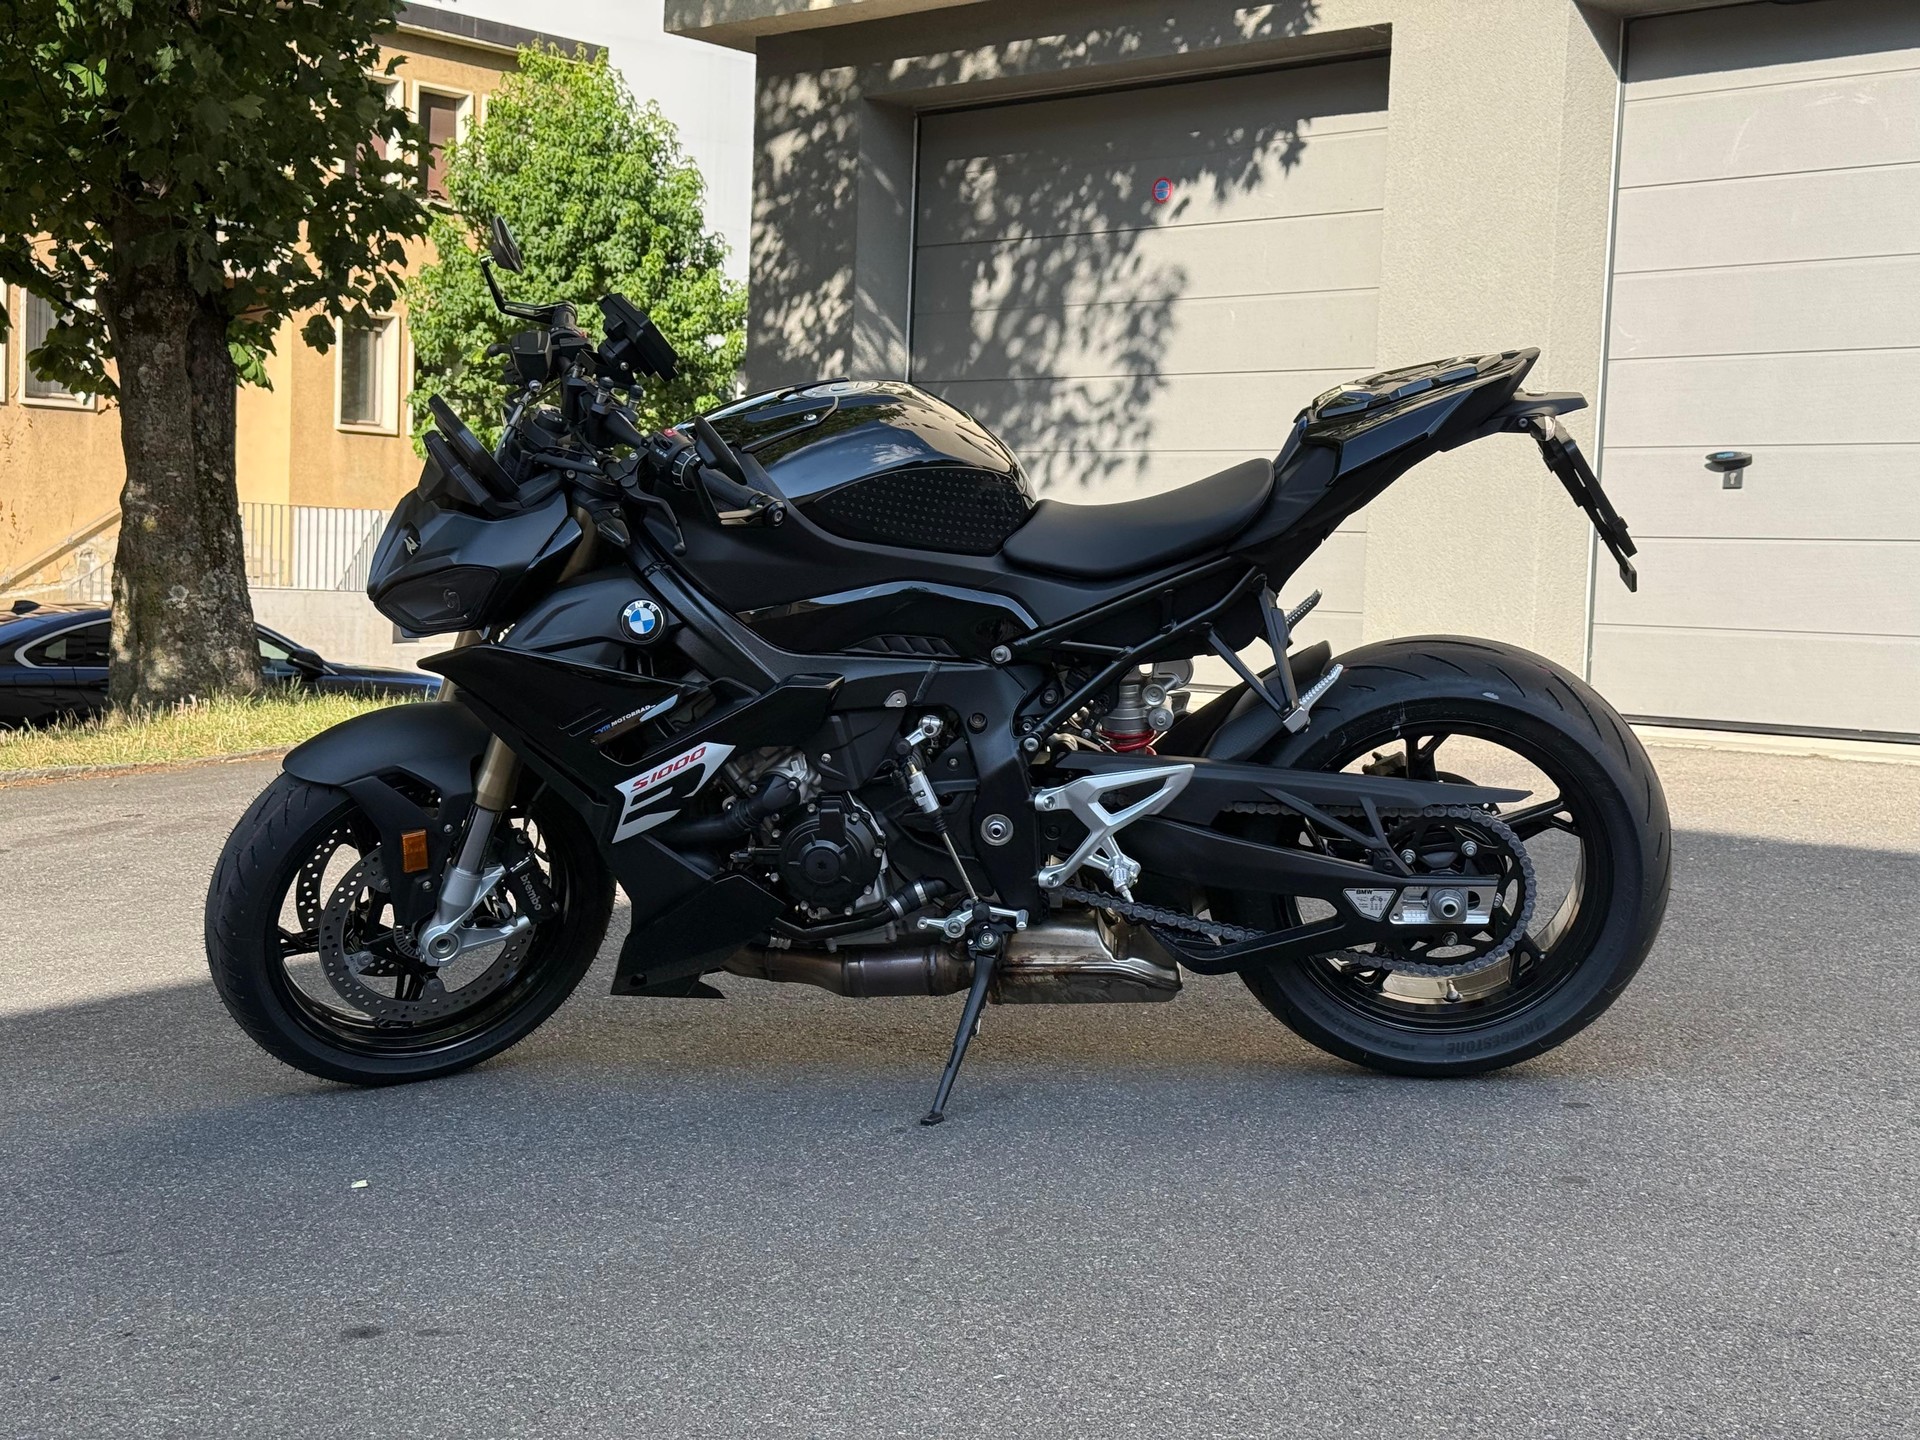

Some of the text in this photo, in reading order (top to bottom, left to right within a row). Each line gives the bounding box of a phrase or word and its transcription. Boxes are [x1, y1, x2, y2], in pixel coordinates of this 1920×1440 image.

[623, 601, 659, 617] BMW
[610, 705, 651, 727] MOTORRAD
[630, 746, 707, 793] S1000
[519, 872, 542, 911] brembo
[1446, 1014, 1548, 1055] BRIDGESTONE
